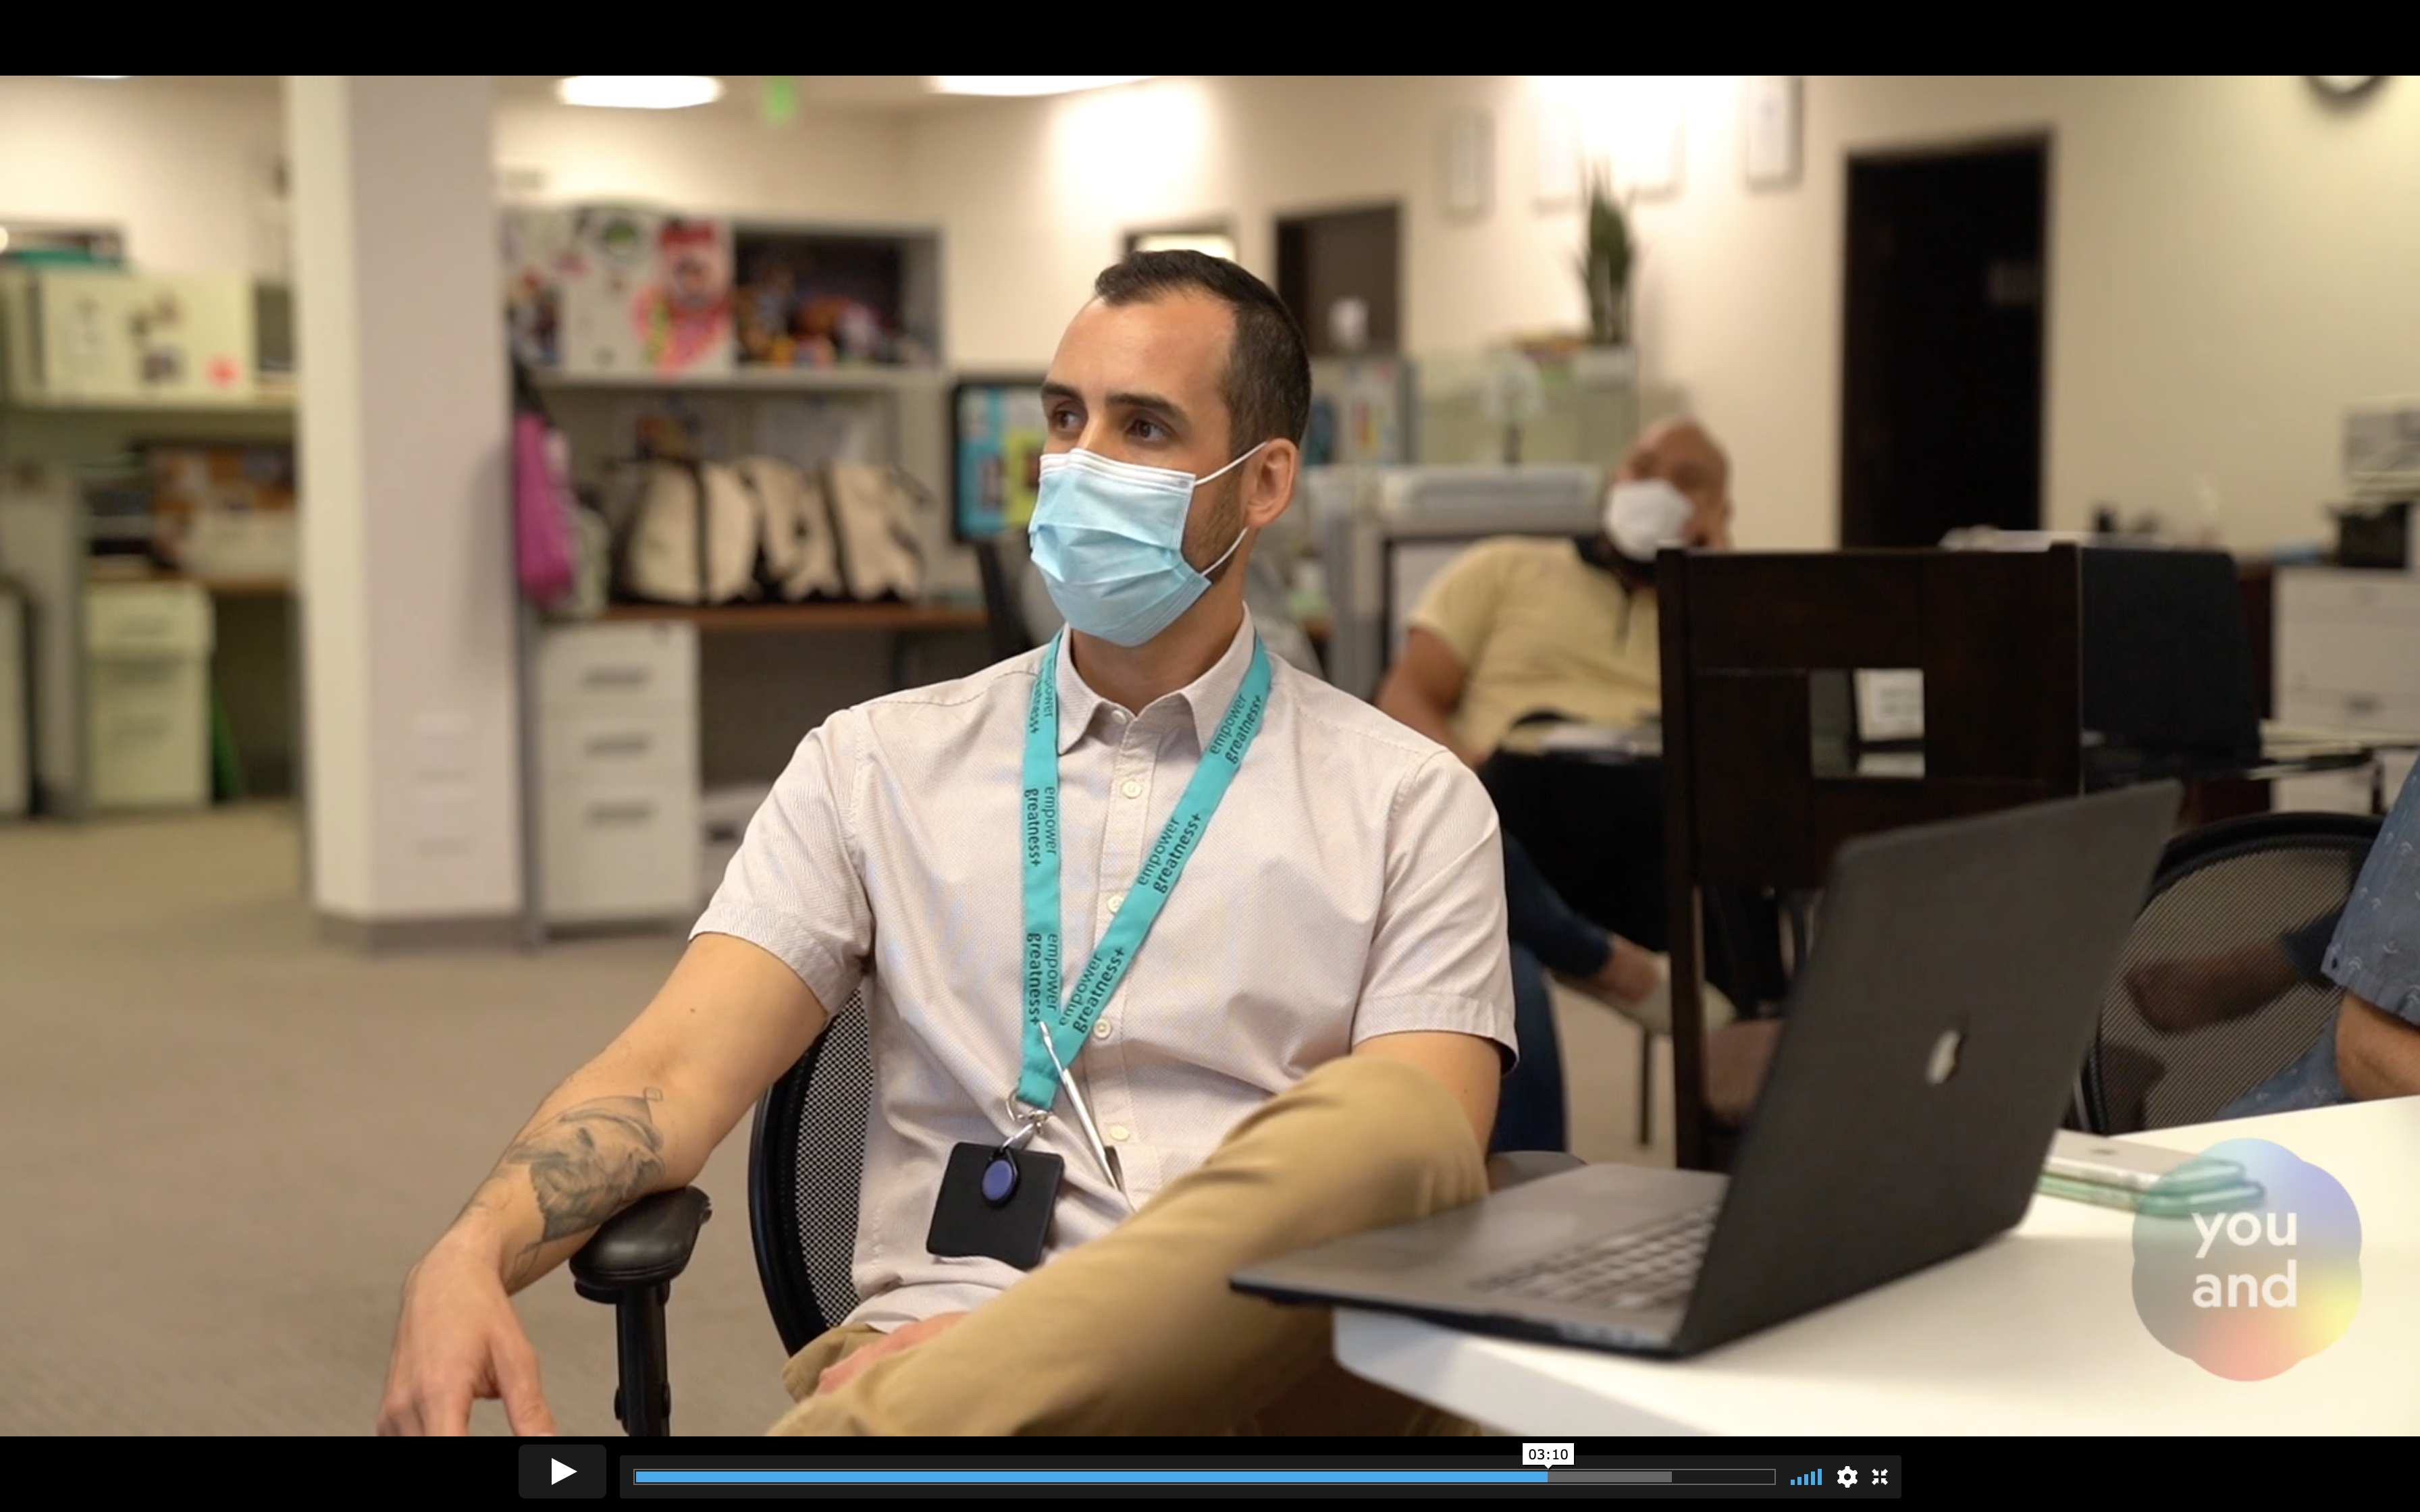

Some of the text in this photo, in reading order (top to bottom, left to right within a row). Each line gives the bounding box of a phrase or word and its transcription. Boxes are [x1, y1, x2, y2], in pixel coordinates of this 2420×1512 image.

[1209, 693, 1246, 755] empower
[1024, 788, 1041, 867] greatness+
[1041, 786, 1057, 855] empower
[1136, 817, 1180, 886] empower
[1153, 813, 1201, 894] greatness+
[1026, 933, 1042, 1025] greatness+
[1045, 933, 1058, 1011] empower
[1059, 953, 1103, 1026] empower
[1072, 947, 1124, 1034] greatness+
